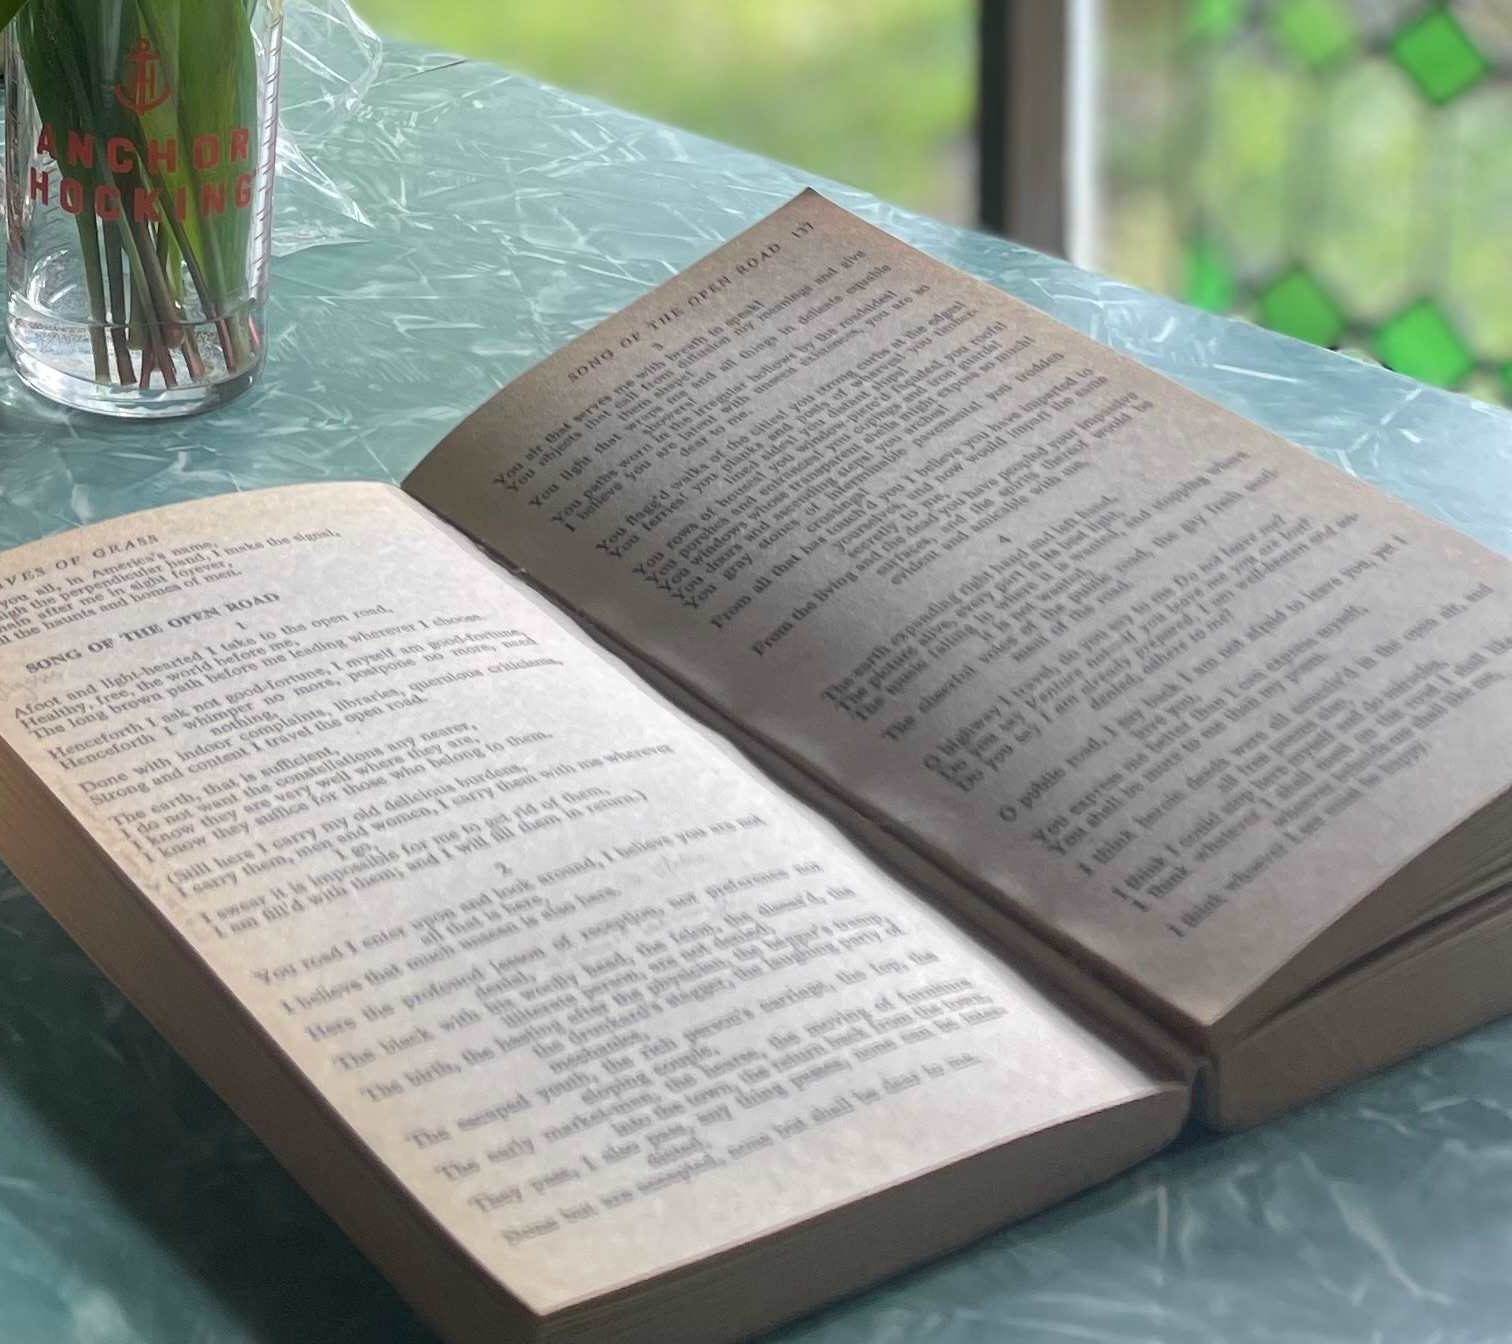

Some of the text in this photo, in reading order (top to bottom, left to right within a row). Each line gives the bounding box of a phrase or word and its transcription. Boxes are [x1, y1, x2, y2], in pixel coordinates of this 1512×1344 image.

[30, 168, 255, 223] HOCKING
[38, 124, 249, 174] ANCHOR
[567, 221, 814, 380] SONG OF THE OPEN ROAD 137
[493, 463, 524, 485] You
[526, 445, 543, 460] air
[545, 422, 572, 443] that
[573, 395, 612, 422] serves
[613, 380, 634, 394] me
[635, 362, 666, 379] with
[664, 336, 707, 361] breath
[708, 327, 724, 336] to
[30, 597, 56, 609] the
[59, 565, 162, 602] perpendicular
[164, 552, 211, 569] hand,
[211, 549, 220, 557] I
[223, 542, 265, 554] make
[266, 537, 290, 546] the
[293, 529, 341, 541] signal,
[35, 583, 62, 595] all,
[65, 577, 84, 585] in
[92, 553, 166, 579] America's
[171, 542, 218, 556] name,
[37, 603, 73, 619] after
[79, 594, 103, 605] me
[107, 588, 126, 596] in
[130, 575, 168, 590] sight
[171, 561, 233, 578] forever,
[55, 555, 80, 570] OF
[92, 534, 159, 558] GRASS
[13, 627, 41, 639] the
[41, 609, 97, 629] haunts
[99, 597, 128, 612] and
[129, 584, 182, 602] homes
[183, 577, 200, 587] of
[203, 570, 241, 582] men.
[25, 593, 280, 673] SONG OF THE OPEN ROAD
[15, 604, 394, 718] Afoot and light-hearted I take to the open road,
[19, 640, 300, 728] Healthy, free, the world before me,
[28, 725, 66, 739] The
[67, 711, 109, 727] long
[107, 693, 163, 714] brown
[166, 678, 204, 698] path
[204, 663, 258, 683] before
[261, 655, 286, 667] me
[288, 640, 348, 658] leading
[348, 624, 416, 643] wherever
[418, 620, 429, 628] I
[47, 723, 145, 759] Henceforth
[146, 717, 156, 727] I
[161, 708, 190, 722] ask
[193, 698, 221, 713] not
[225, 668, 332, 704] good-fortune,
[330, 661, 342, 671] I
[346, 647, 395, 668] myself
[400, 644, 425, 654] am
[59, 734, 156, 770] Henceforth
[163, 726, 174, 736] I
[183, 703, 253, 729] whimper
[263, 694, 285, 705] no
[293, 679, 341, 696] more,
[347, 658, 416, 683] postpone
[422, 653, 444, 661] no
[452, 644, 497, 655] more,
[78, 773, 128, 792] Done
[132, 758, 172, 775] with
[176, 738, 232, 761] indoor
[239, 710, 332, 740] complaints,
[332, 689, 406, 712] libraries,
[408, 669, 484, 693] querulous
[89, 694, 428, 805] Strong and content I travel the open road.
[210, 711, 279, 735] nothing,
[108, 748, 340, 826] The earth, that is sufficient,
[120, 723, 478, 838] I do not want the constellations any nearer,
[133, 736, 480, 850] I know they are very well where they are,
[143, 732, 553, 862] I know they suffice for those who belong to them.
